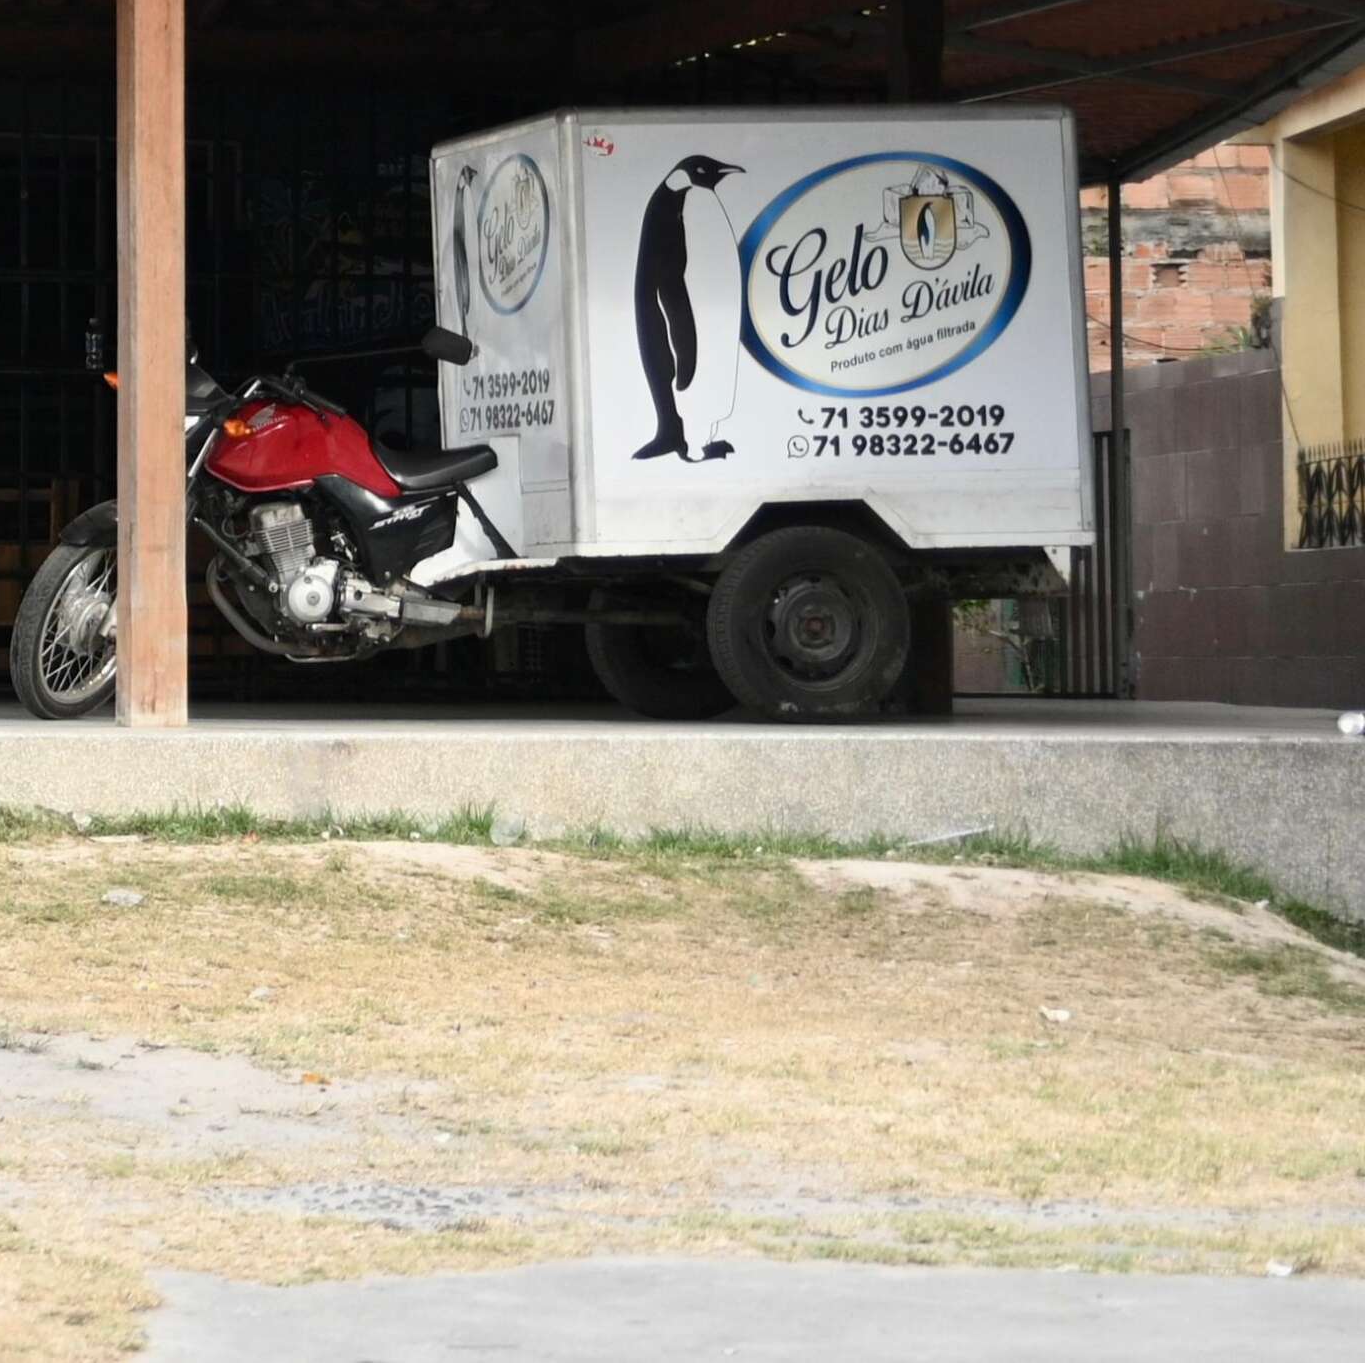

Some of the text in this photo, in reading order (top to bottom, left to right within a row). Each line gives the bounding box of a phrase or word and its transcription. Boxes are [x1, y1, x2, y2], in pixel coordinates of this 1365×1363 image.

[765, 222, 889, 348] Gelo
[824, 305, 890, 350] Dias
[830, 320, 977, 373] Produto com água filtrada
[472, 368, 550, 401] 71 3599-2019
[469, 399, 555, 432] 71 98322-6467
[820, 404, 1006, 429] 71 3599-2019
[812, 432, 1016, 457] 71 98322-6467
